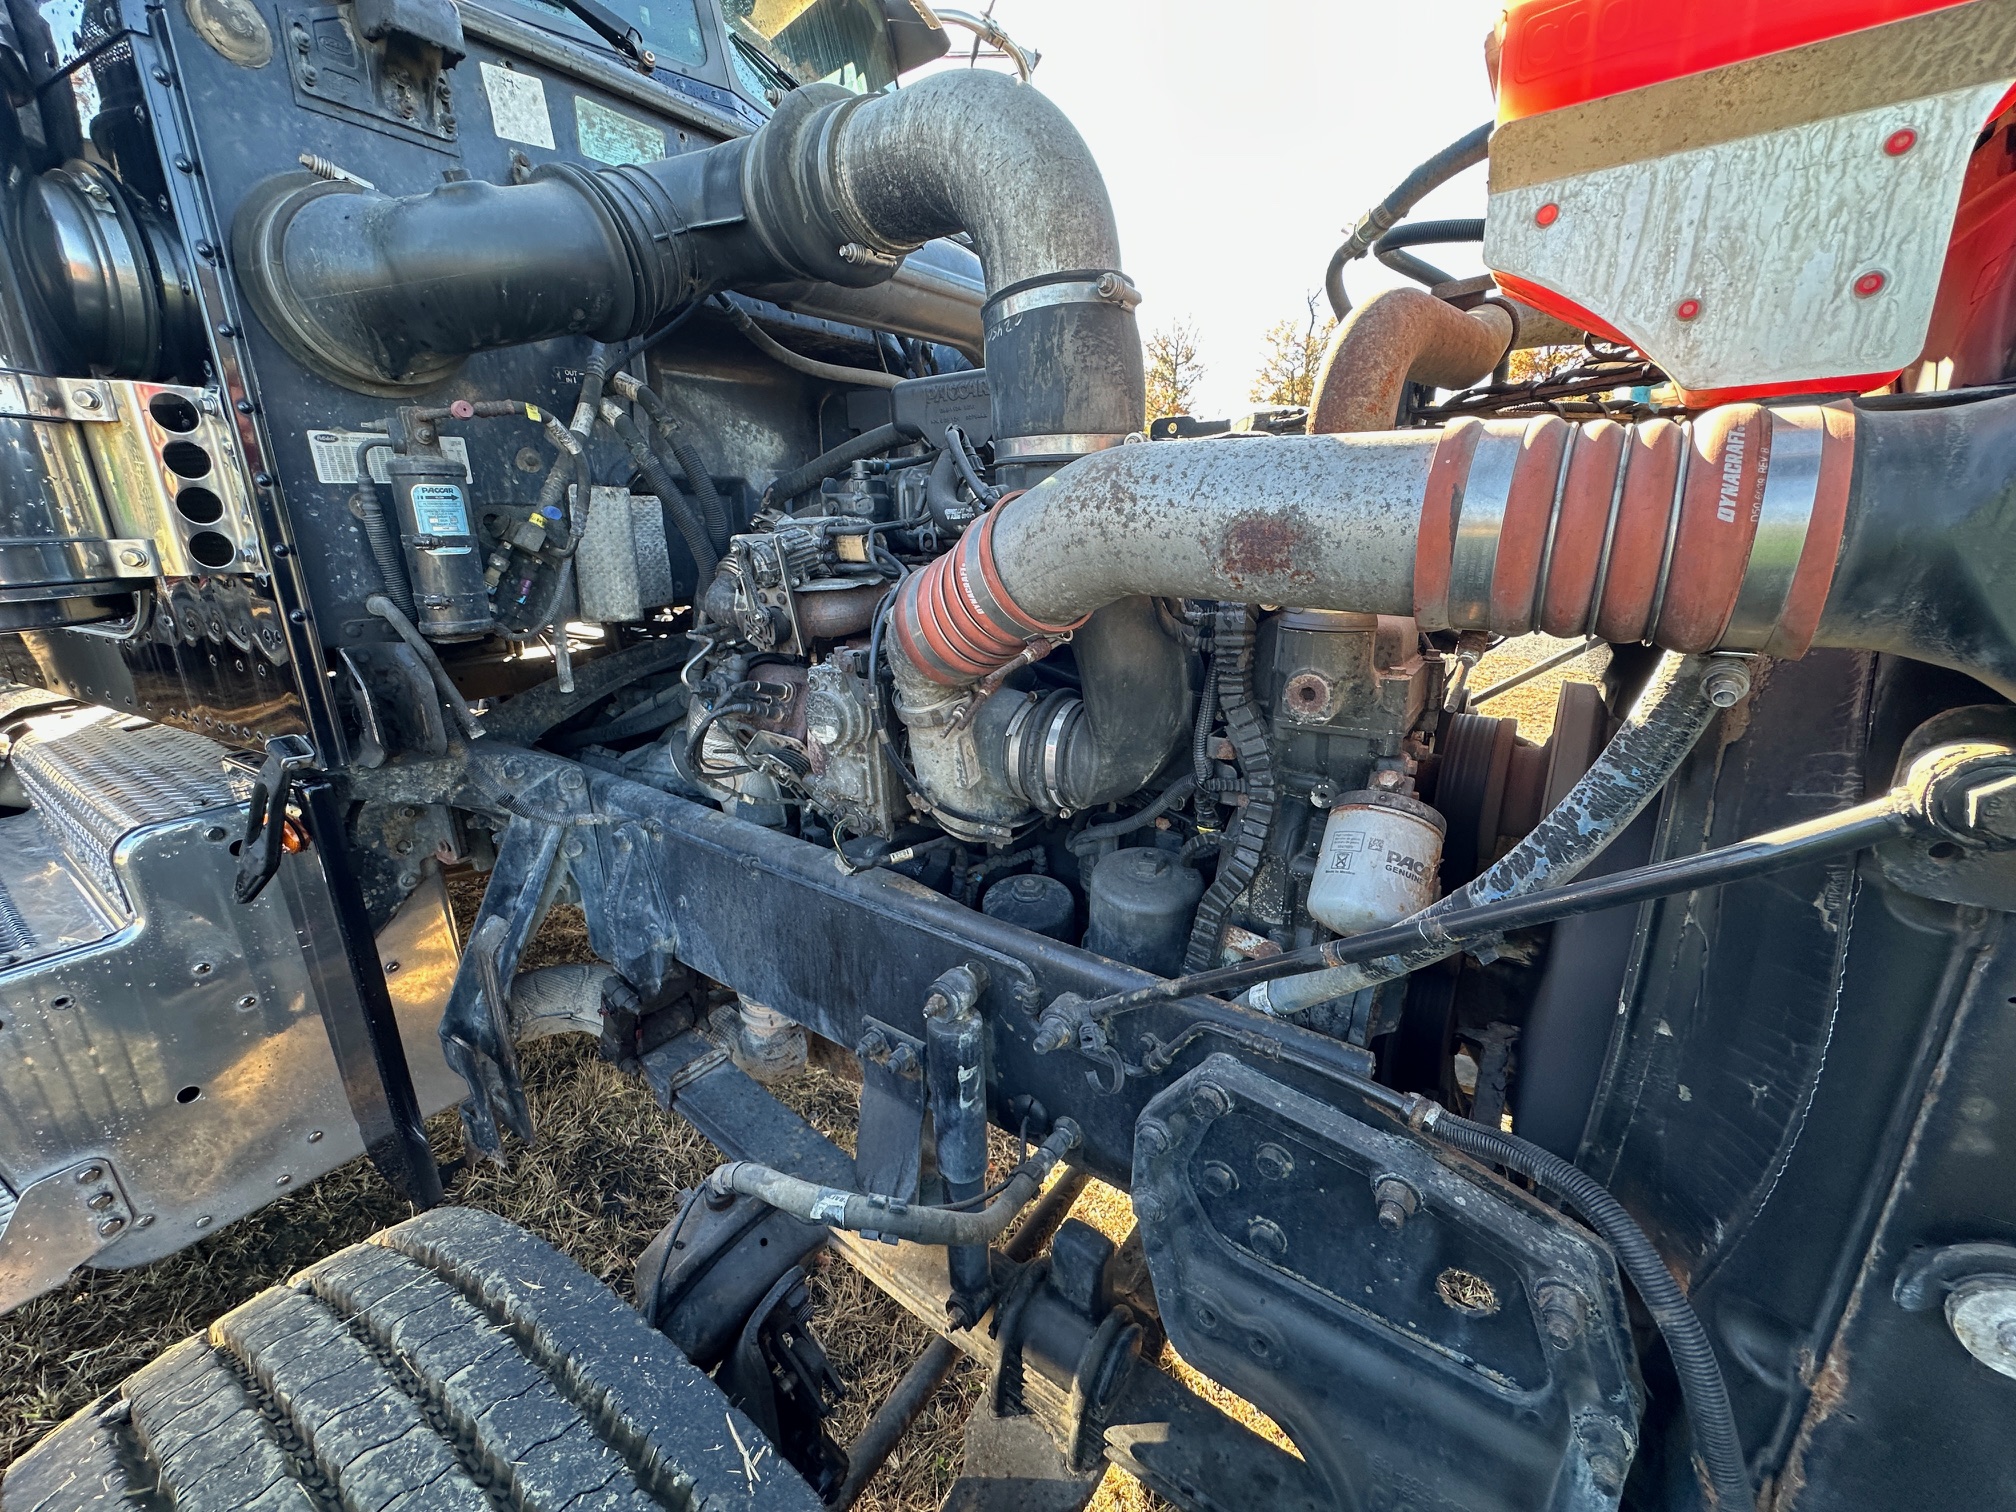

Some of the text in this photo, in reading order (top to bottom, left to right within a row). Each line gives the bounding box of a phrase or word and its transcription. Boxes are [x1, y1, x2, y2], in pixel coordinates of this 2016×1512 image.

[564, 369, 577, 377] OUT
[1758, 456, 1769, 474] REV
[1717, 429, 1746, 523] DYNACRAFT
